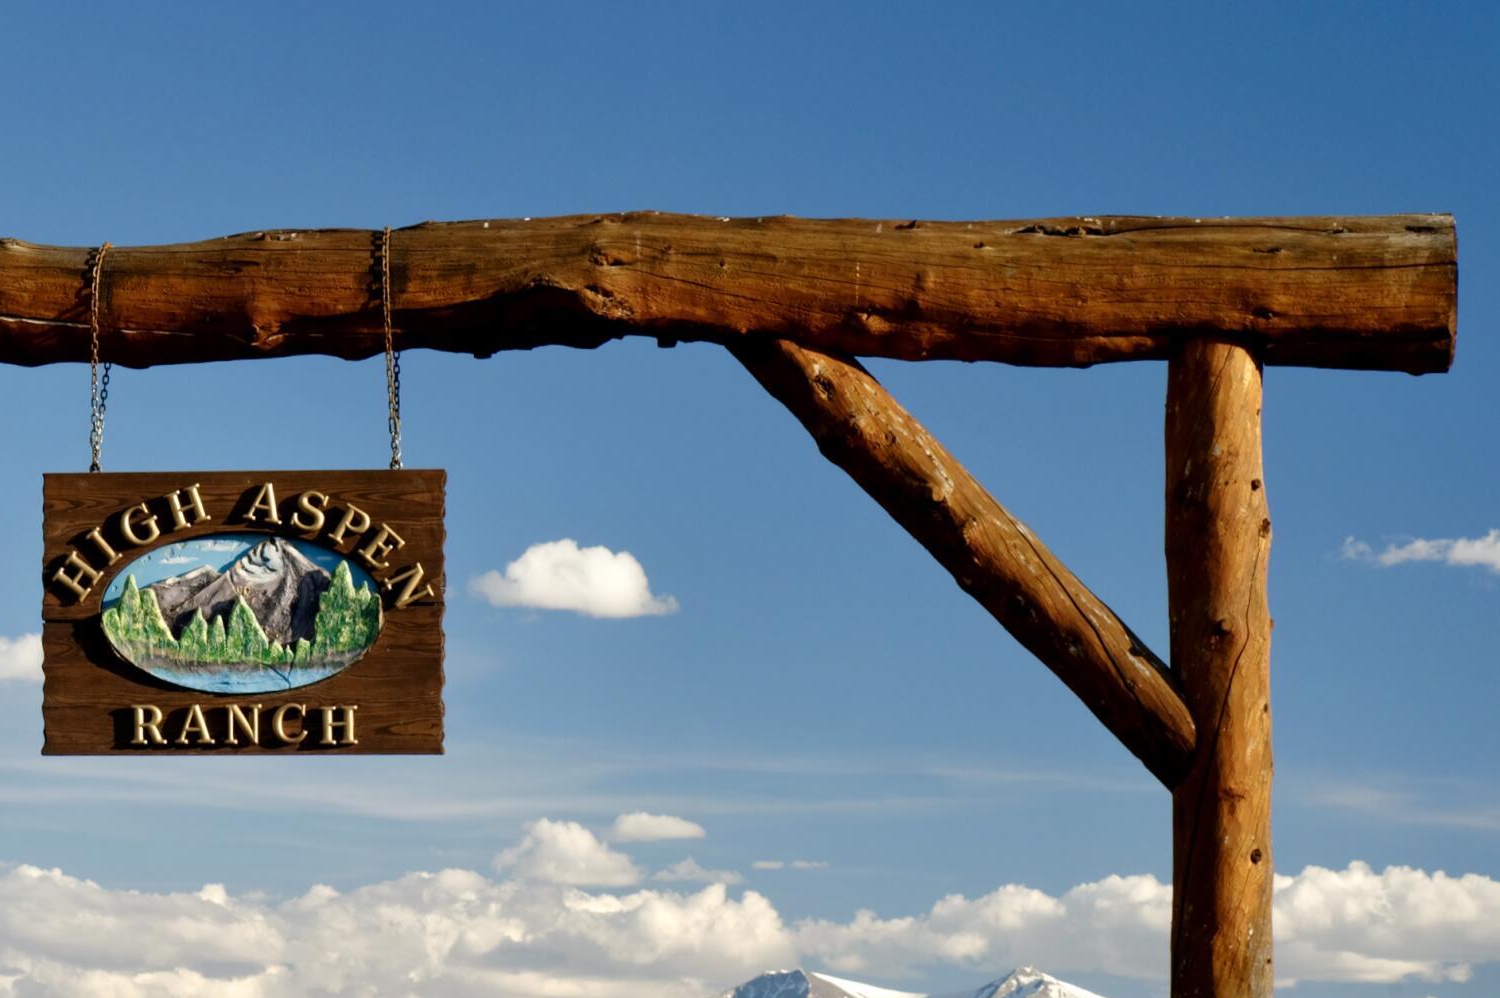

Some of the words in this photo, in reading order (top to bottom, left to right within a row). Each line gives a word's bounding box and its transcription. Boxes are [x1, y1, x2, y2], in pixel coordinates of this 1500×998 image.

[52, 483, 211, 602] HIGH
[243, 482, 435, 609] ASPEN
[130, 703, 359, 746] RANCH
